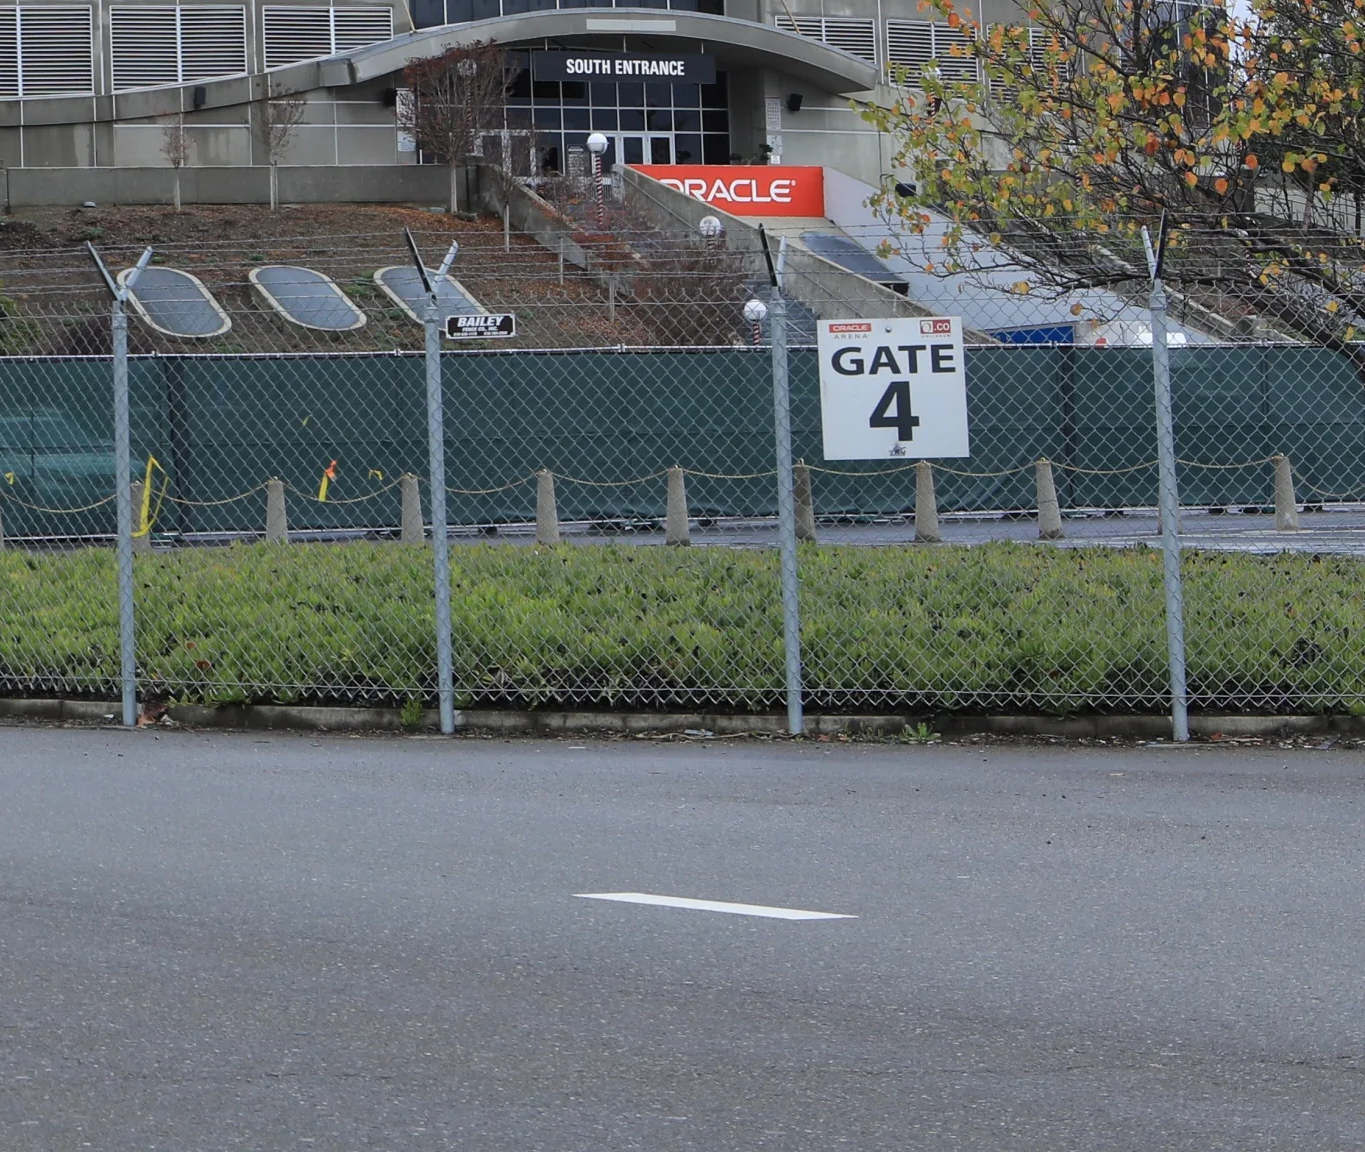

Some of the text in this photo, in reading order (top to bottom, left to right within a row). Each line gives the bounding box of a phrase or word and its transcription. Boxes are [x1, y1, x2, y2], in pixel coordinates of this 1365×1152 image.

[566, 58, 685, 77] SOUTH ENTRANCE
[456, 315, 505, 328] BAILEY
[832, 324, 869, 332] ORACLE
[831, 343, 957, 376] GATE
[869, 380, 920, 442] 4
